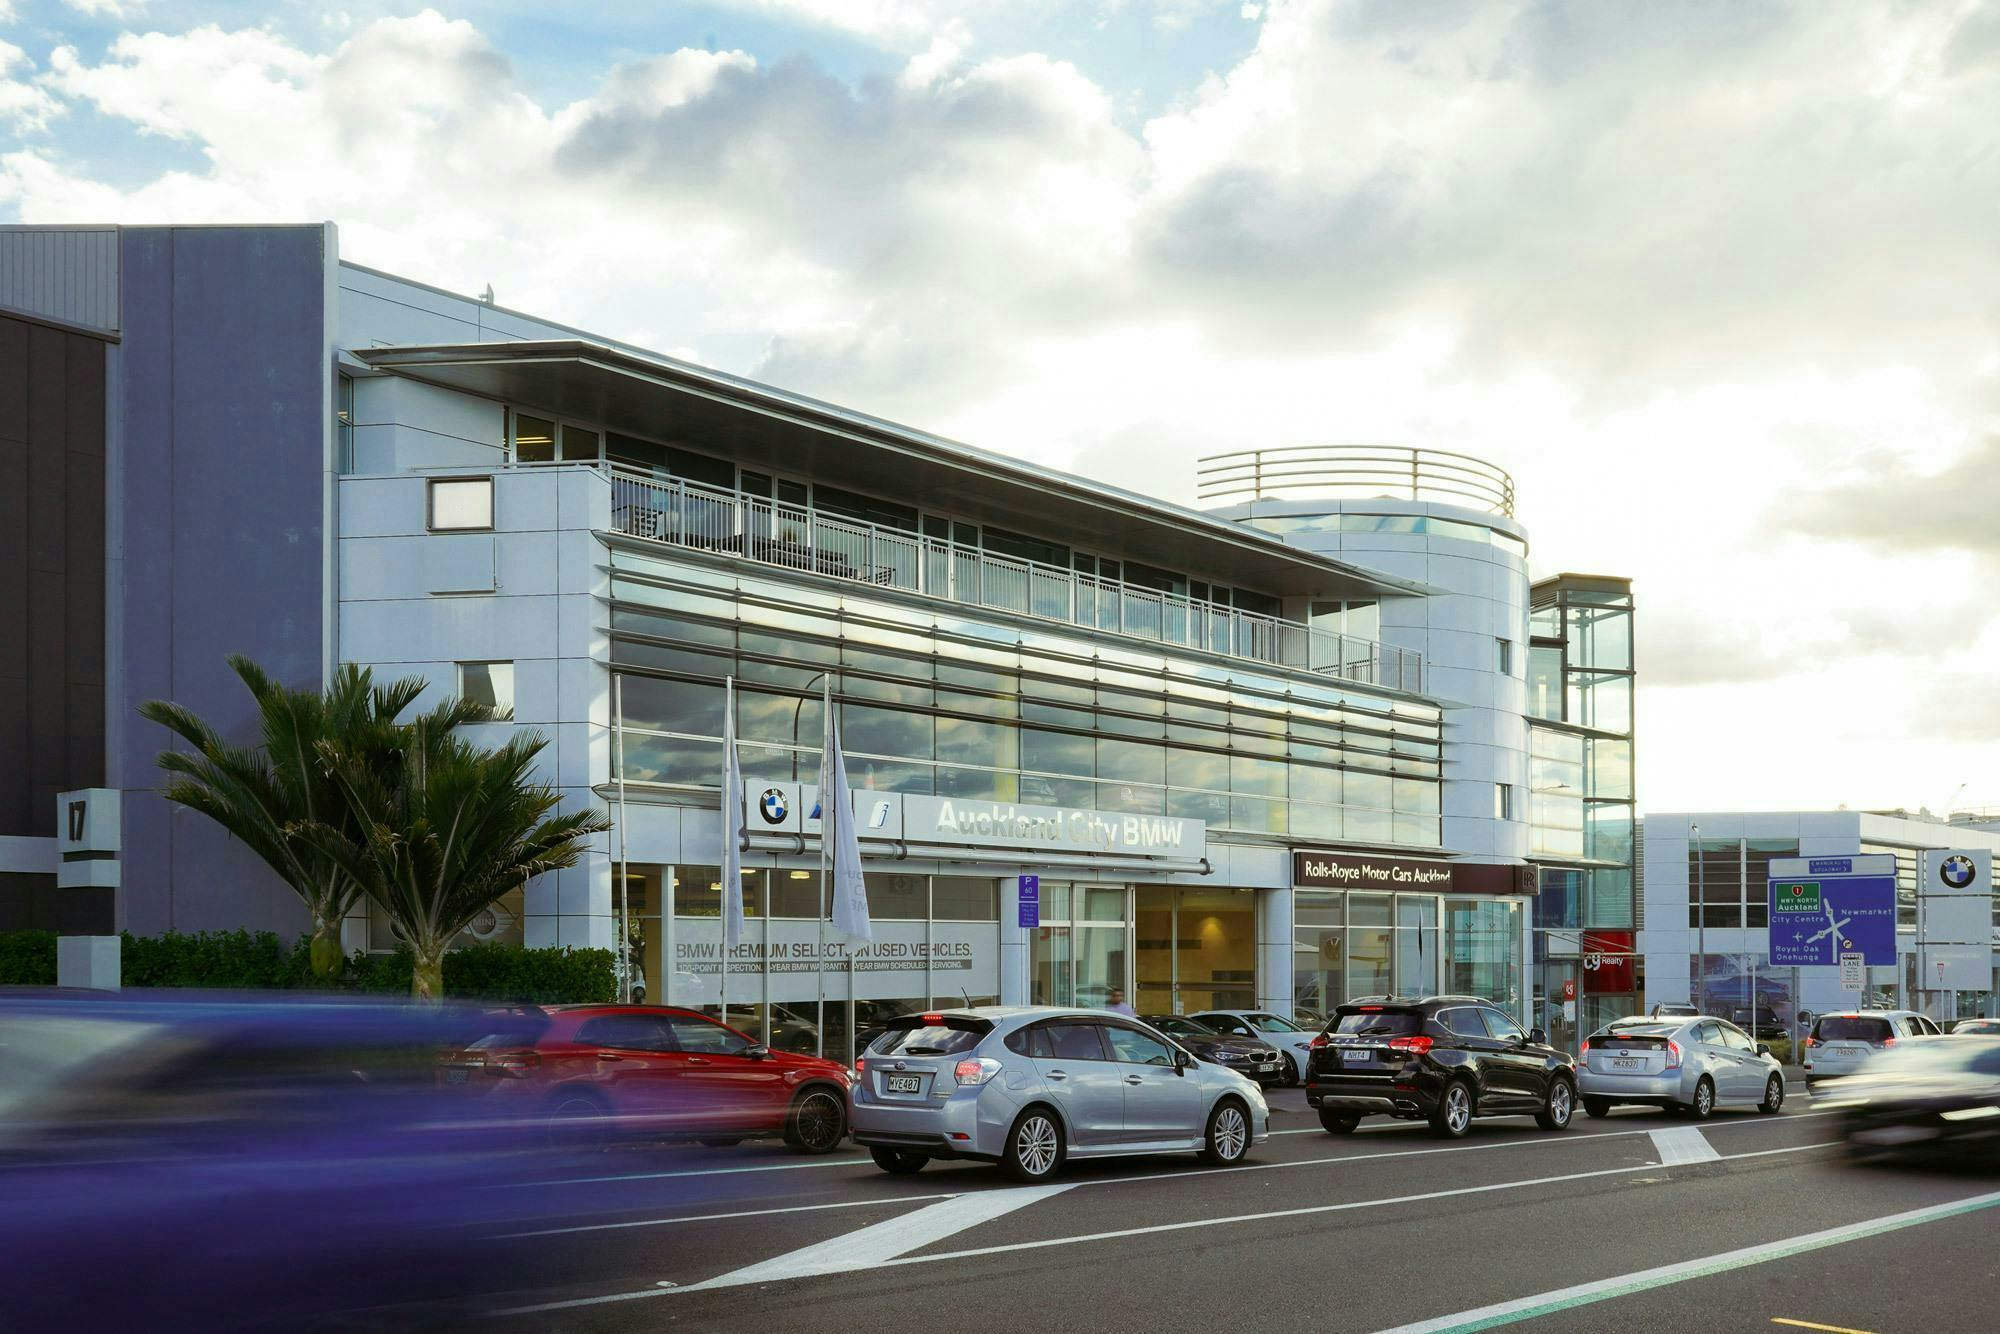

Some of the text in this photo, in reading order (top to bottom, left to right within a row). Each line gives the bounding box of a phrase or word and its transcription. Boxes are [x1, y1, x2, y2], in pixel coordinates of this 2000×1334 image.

[763, 788, 786, 802] BMW
[69, 800, 86, 842] 17
[936, 800, 1184, 851] Auckland City BMW
[1305, 860, 1450, 884] Rolls-Royce Motor Cars Auckland
[1025, 877, 1032, 885] P
[1025, 886, 1033, 894] 60
[1841, 908, 1892, 916] Newmarket
[473, 917, 495, 927] MINI
[1771, 915, 1825, 924] City Centre
[676, 943, 715, 958] BMW
[791, 943, 870, 958] SELECTN
[873, 943, 907, 957] USED
[910, 943, 972, 957] VEHICLES.
[1775, 945, 1799, 955] Royal
[1602, 956, 1624, 966] Realty
[1777, 953, 1819, 961] Onehunga
[679, 961, 963, 972] 100-POINT ISPECTION. -YEAR BMW WARANTY. -YEAR BMW SCHEDULED SERVICING.
[889, 1077, 919, 1091] MYE407
